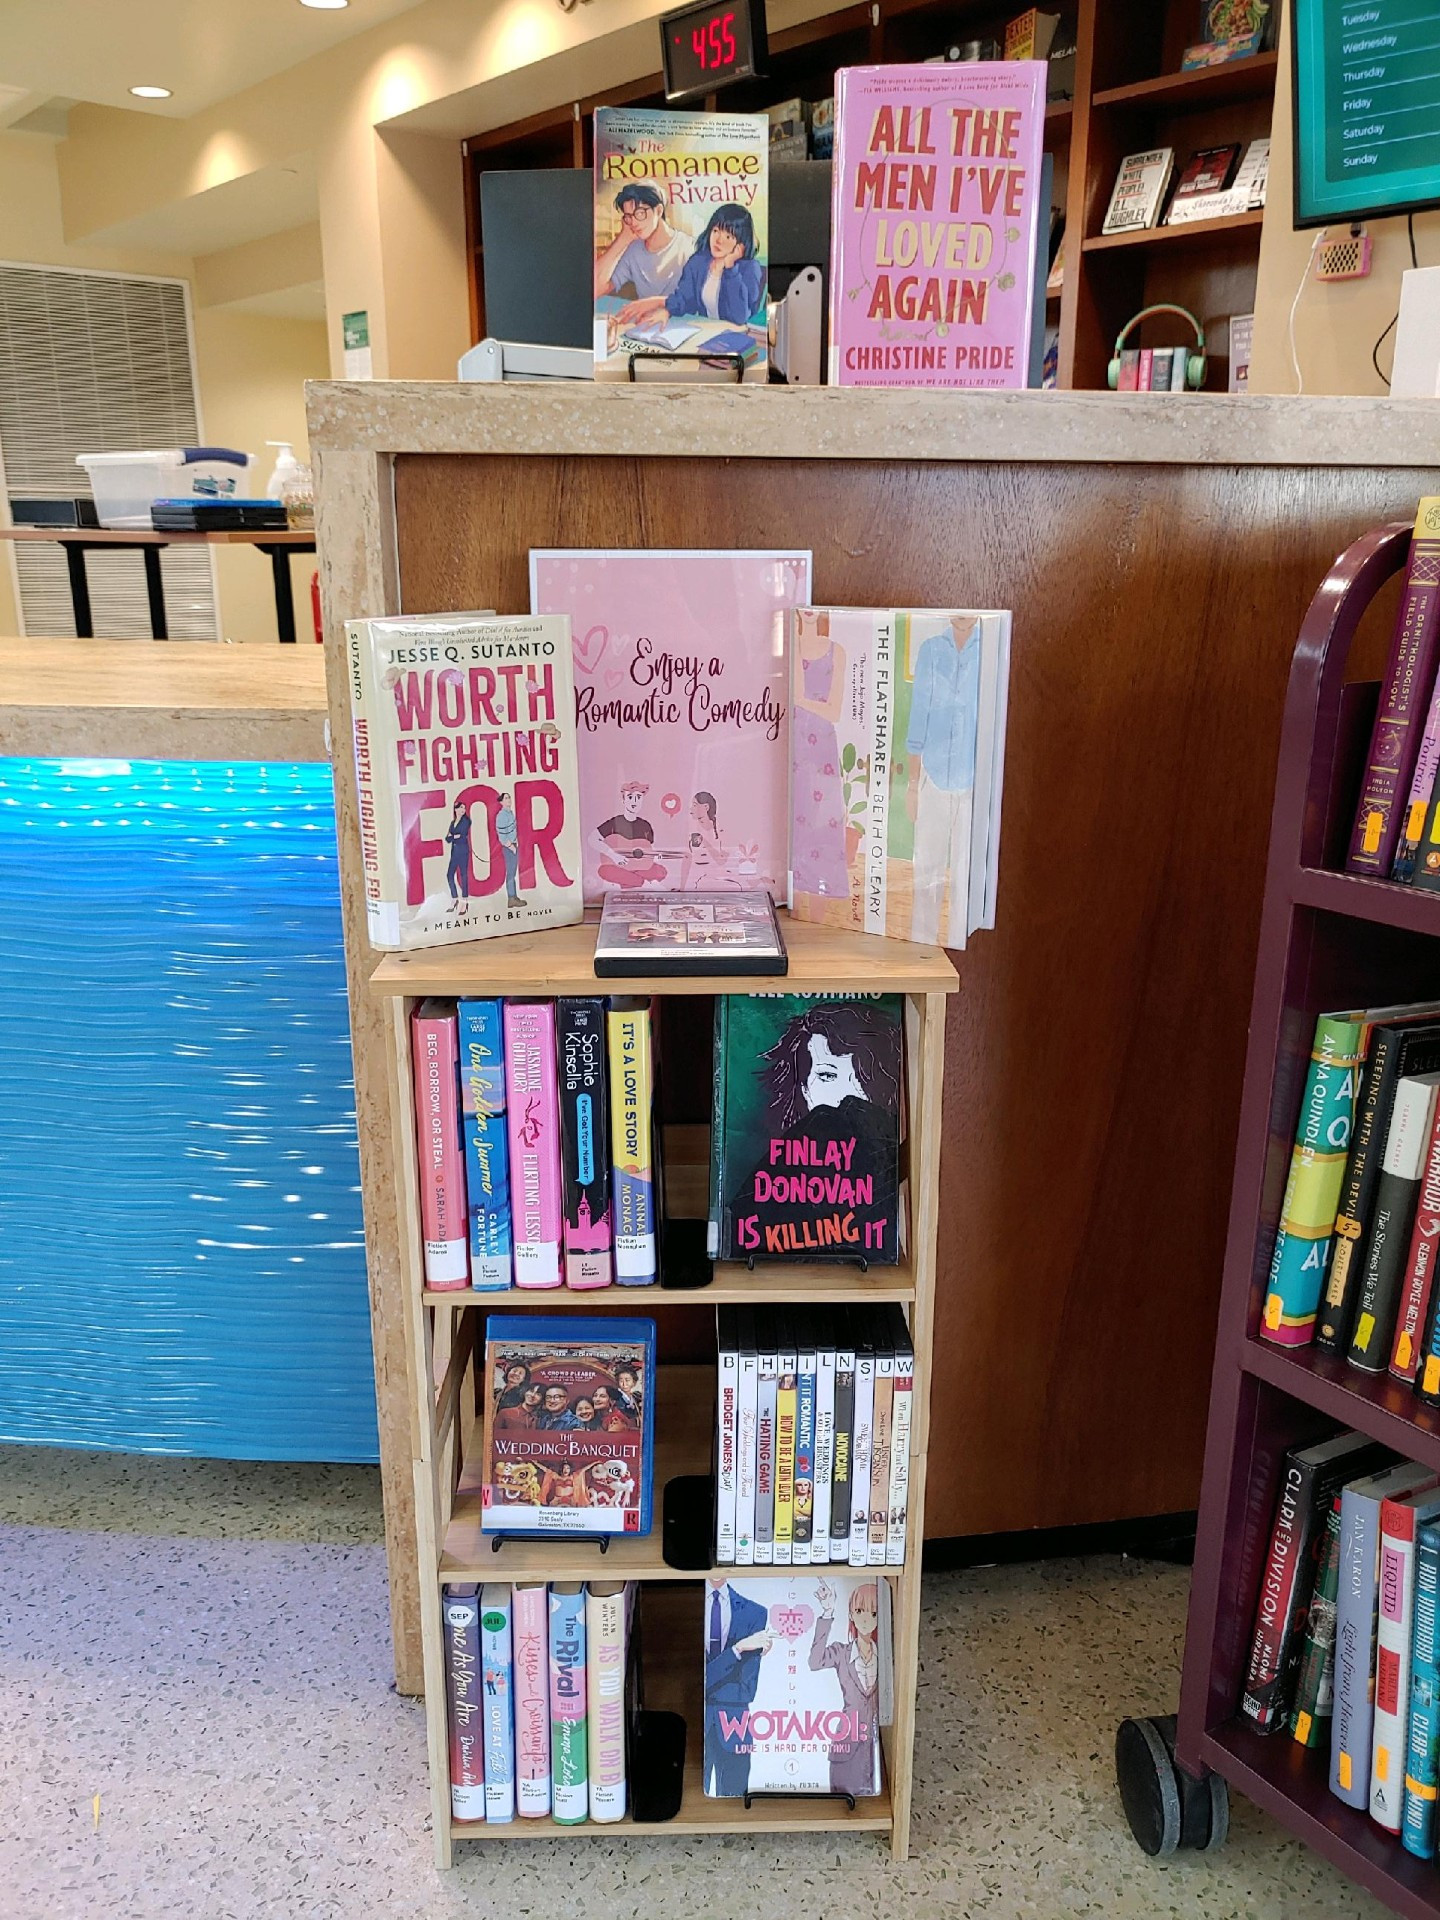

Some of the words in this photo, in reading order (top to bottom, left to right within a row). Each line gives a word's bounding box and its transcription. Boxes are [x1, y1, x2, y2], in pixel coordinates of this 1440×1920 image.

[1342, 10, 1380, 27] Tuesday
[1343, 35, 1397, 54] Wednesday
[1343, 66, 1385, 82] Thursday
[1343, 98, 1372, 111] Friday
[638, 140, 665, 153] The
[868, 105, 936, 156] ALL
[949, 108, 1022, 159] THE
[1343, 124, 1384, 139] Saturday
[606, 152, 760, 180] Romance
[1122, 169, 1143, 181] WHITE
[1343, 154, 1378, 168] Sunday
[668, 179, 759, 206] Rivalry
[855, 162, 937, 212] MEN
[950, 165, 1026, 217] I'VE
[1108, 207, 1147, 225] HUGHLEY
[875, 219, 994, 271] LOVED
[867, 274, 988, 325] AGAIN
[845, 346, 947, 370] CHRISTINE
[955, 346, 1015, 370] PRIDE
[1405, 597, 1417, 627] FIELD
[1420, 596, 1428, 610] THE
[388, 647, 440, 664] JESSE
[444, 646, 465, 663] Q.
[471, 641, 556, 659] SUTANTO
[877, 626, 890, 661] THE
[1398, 631, 1410, 661] GUIDE
[350, 633, 362, 700] SUTANTO
[630, 638, 704, 696] Enjoy
[708, 657, 724, 677] a
[1395, 666, 1402, 677] TO
[1398, 613, 1425, 712] ORNITHOLOGIST'S
[393, 663, 556, 731] WORTH
[1388, 680, 1400, 708] LOVE
[574, 686, 681, 732] Romantic
[688, 684, 786, 741] Comedy
[874, 669, 889, 775] FLATSHARE
[355, 718, 372, 785] WORTH
[397, 731, 559, 787] FIGHTING
[1413, 736, 1437, 794] Portrait
[1367, 786, 1394, 794] HOLTON
[1372, 778, 1391, 786] INDIA
[359, 789, 380, 873] FIGHTING
[872, 794, 884, 839] BETH
[399, 779, 575, 906] FOR
[854, 876, 861, 887] A
[869, 845, 883, 918] O'LEARY
[434, 917, 479, 931] MEANT
[485, 913, 501, 923] TO
[508, 911, 521, 920] BE
[527, 908, 553, 916] NOVEL
[851, 893, 862, 923] Novel
[427, 1033, 438, 1059] BEG,
[622, 1023, 634, 1051] IT'S
[468, 1043, 492, 1072] One
[512, 1042, 528, 1095] GUILLORY
[527, 1043, 542, 1092] JASMINE
[565, 1032, 582, 1090] Kinsella
[581, 1033, 599, 1087] Sophie
[623, 1055, 635, 1065] A
[1316, 1033, 1336, 1080] ANNA
[428, 1062, 441, 1116] BORROW,
[624, 1070, 636, 1106] LOVE
[1367, 1043, 1387, 1105] SLEEPING
[468, 1076, 494, 1134] Golden
[431, 1118, 442, 1134] OR
[625, 1111, 638, 1157] STORY
[1301, 1085, 1327, 1168] QUINDLEN
[1360, 1111, 1374, 1146] WITH
[432, 1136, 444, 1170] STEAL
[472, 1137, 494, 1197] Summer
[769, 1135, 857, 1171] FINLAY
[1354, 1152, 1366, 1177] THE
[523, 1154, 541, 1206] FLIRTING
[754, 1171, 873, 1208] DONOVAN
[1422, 1140, 1440, 1213] WARRIOR
[436, 1187, 446, 1220] SARAH
[1345, 1182, 1361, 1219] DEVIL
[476, 1208, 487, 1258] FORTUNE
[489, 1213, 500, 1254] CARLEY
[738, 1214, 761, 1249] IS
[765, 1212, 860, 1253] KILLING
[864, 1218, 888, 1249] IT
[1378, 1210, 1391, 1230] The
[1269, 1250, 1283, 1284] SIDE
[1368, 1231, 1387, 1271] Stories
[1414, 1242, 1431, 1278] GLENNON
[1367, 1272, 1379, 1290] We
[1409, 1278, 1424, 1305] DOYLE
[1362, 1291, 1376, 1311] Tell
[1404, 1305, 1419, 1336] MELTON
[724, 1356, 734, 1368] B
[744, 1360, 754, 1372] F
[762, 1358, 773, 1370] H
[783, 1358, 793, 1370] H
[822, 1355, 831, 1367] L
[839, 1355, 850, 1367] N
[860, 1362, 871, 1374] S
[880, 1361, 891, 1372] U
[897, 1361, 912, 1372] W
[723, 1388, 733, 1431] BRIDGET
[780, 1415, 793, 1433] HOW
[799, 1397, 811, 1449] ROMANTIC
[898, 1401, 907, 1420] When
[495, 1440, 567, 1456] WEDDING
[569, 1441, 638, 1458] BANQUET
[560, 1434, 574, 1442] THE
[722, 1433, 733, 1472] JONES'S
[760, 1419, 771, 1458] HATING
[779, 1447, 792, 1456] BE
[780, 1436, 792, 1445] TO
[894, 1422, 909, 1455] Harry
[822, 1438, 831, 1484] WEDDINGS
[835, 1432, 849, 1482] NOVOCAINE
[759, 1463, 770, 1494] GAME
[778, 1465, 791, 1482] LATIN
[778, 1483, 791, 1503] LOVER
[1278, 1468, 1302, 1534] CLARK
[627, 1513, 636, 1525] R
[1354, 1514, 1364, 1546] JAN
[1276, 1531, 1292, 1543] AND
[1261, 1541, 1288, 1627] DIVISION
[1351, 1549, 1363, 1598] KARON
[1384, 1554, 1397, 1614] LIQUID
[1418, 1561, 1437, 1594] RON
[566, 1616, 577, 1637] The
[1415, 1595, 1435, 1664] HUBBARD
[452, 1650, 475, 1668] As
[518, 1632, 540, 1682] Kisses
[556, 1640, 580, 1697] Rival
[598, 1645, 620, 1664] AS
[1247, 1629, 1263, 1681] HIRAHARA
[1258, 1643, 1272, 1681] NAOMI
[451, 1670, 476, 1698] You
[598, 1666, 621, 1696] YOU
[1388, 1660, 1398, 1704] MARIAM
[456, 1701, 478, 1727] Are
[1243, 1692, 1261, 1711] SOHO
[491, 1705, 501, 1732] LOVE
[521, 1698, 547, 1765] Croissants
[600, 1699, 621, 1743] WALK
[718, 1710, 868, 1742] WOTAKOI:
[491, 1735, 501, 1748] AT
[561, 1716, 576, 1755] Emma
[735, 1744, 757, 1754] LOVE
[762, 1743, 770, 1753] IS
[774, 1743, 797, 1753] HARD
[801, 1743, 818, 1753] FOR
[822, 1743, 851, 1753] OTAKU
[1411, 1712, 1430, 1758] CLEAR
[460, 1735, 475, 1770] Dahlia
[600, 1750, 621, 1772] ON
[789, 1782, 797, 1791] by
